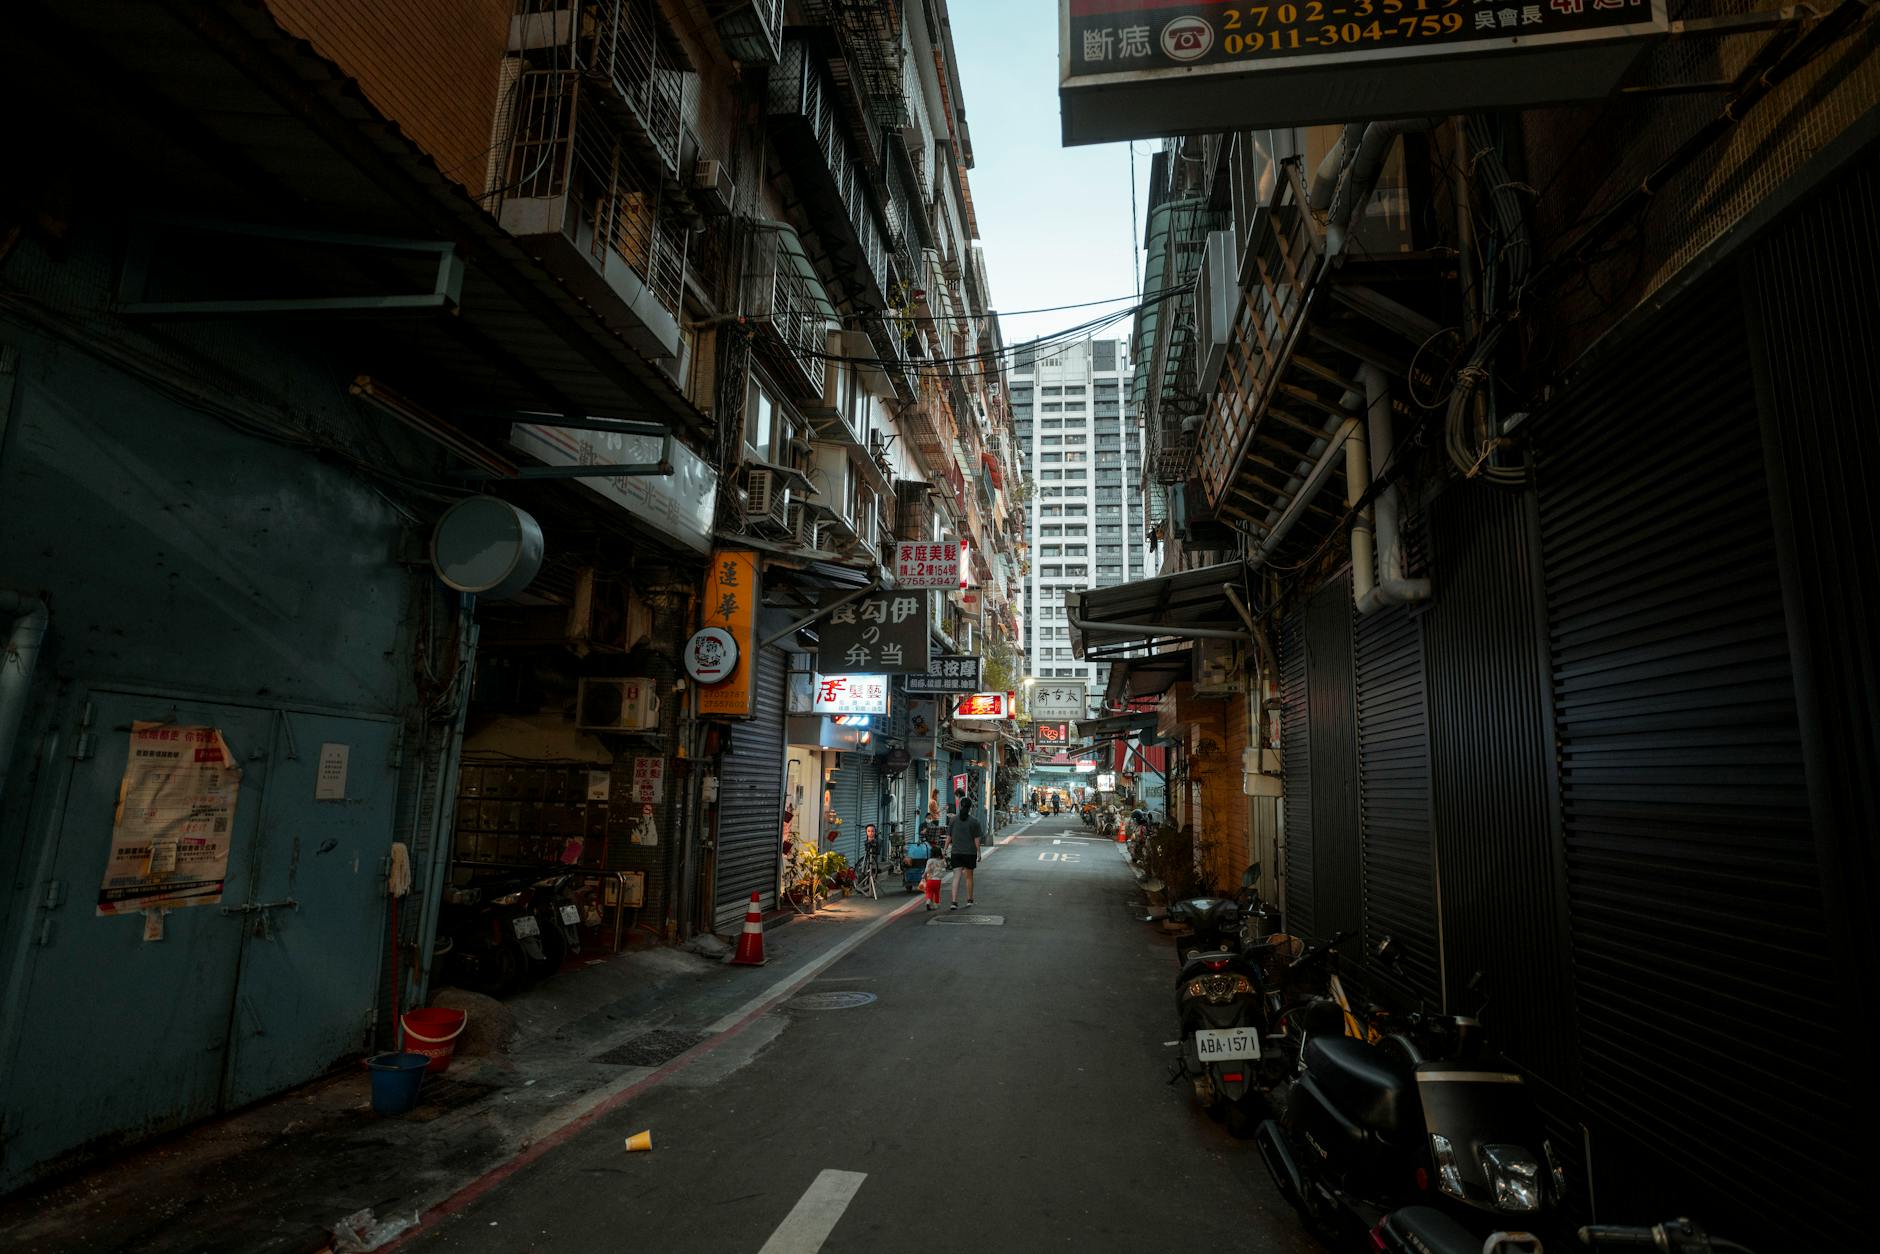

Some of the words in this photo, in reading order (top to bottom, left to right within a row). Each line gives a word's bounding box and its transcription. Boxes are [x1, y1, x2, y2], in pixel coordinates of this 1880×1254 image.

[1474, 5, 1544, 30] 吳會長
[1224, 11, 1464, 55] 0911-304-759
[901, 544, 957, 562] 家庭美髮
[863, 626, 880, 644] の
[844, 643, 903, 666] 弁当
